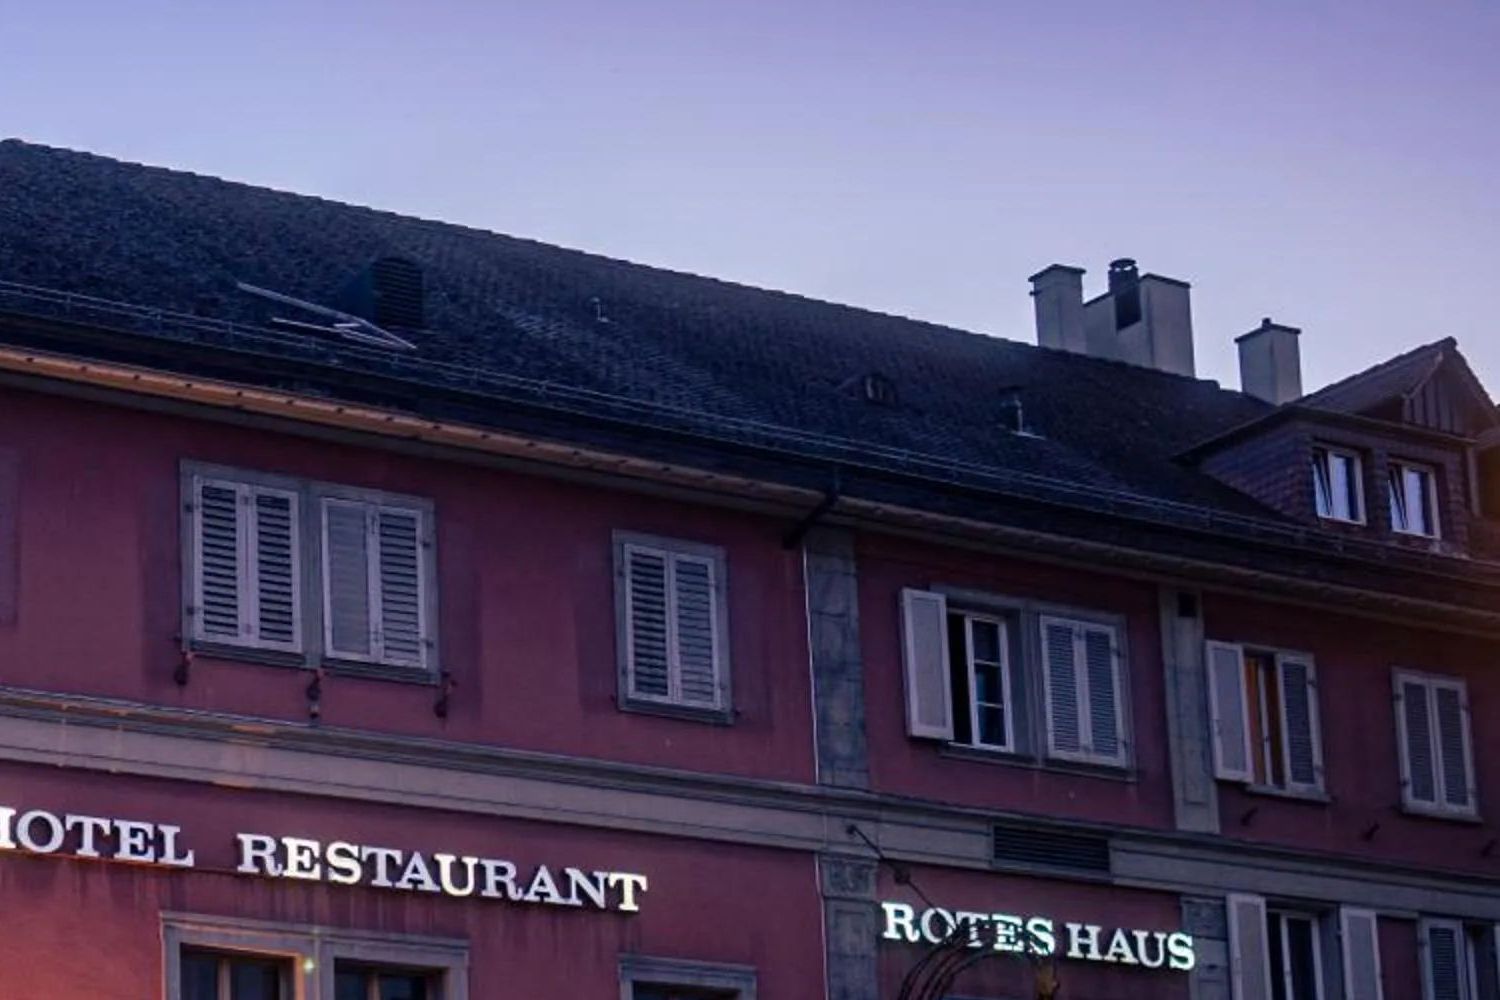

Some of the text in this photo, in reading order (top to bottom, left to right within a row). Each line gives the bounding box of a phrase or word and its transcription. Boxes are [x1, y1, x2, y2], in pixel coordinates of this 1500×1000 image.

[237, 832, 647, 913] RESTAURANT
[881, 901, 1197, 972] ROTES HAUS
